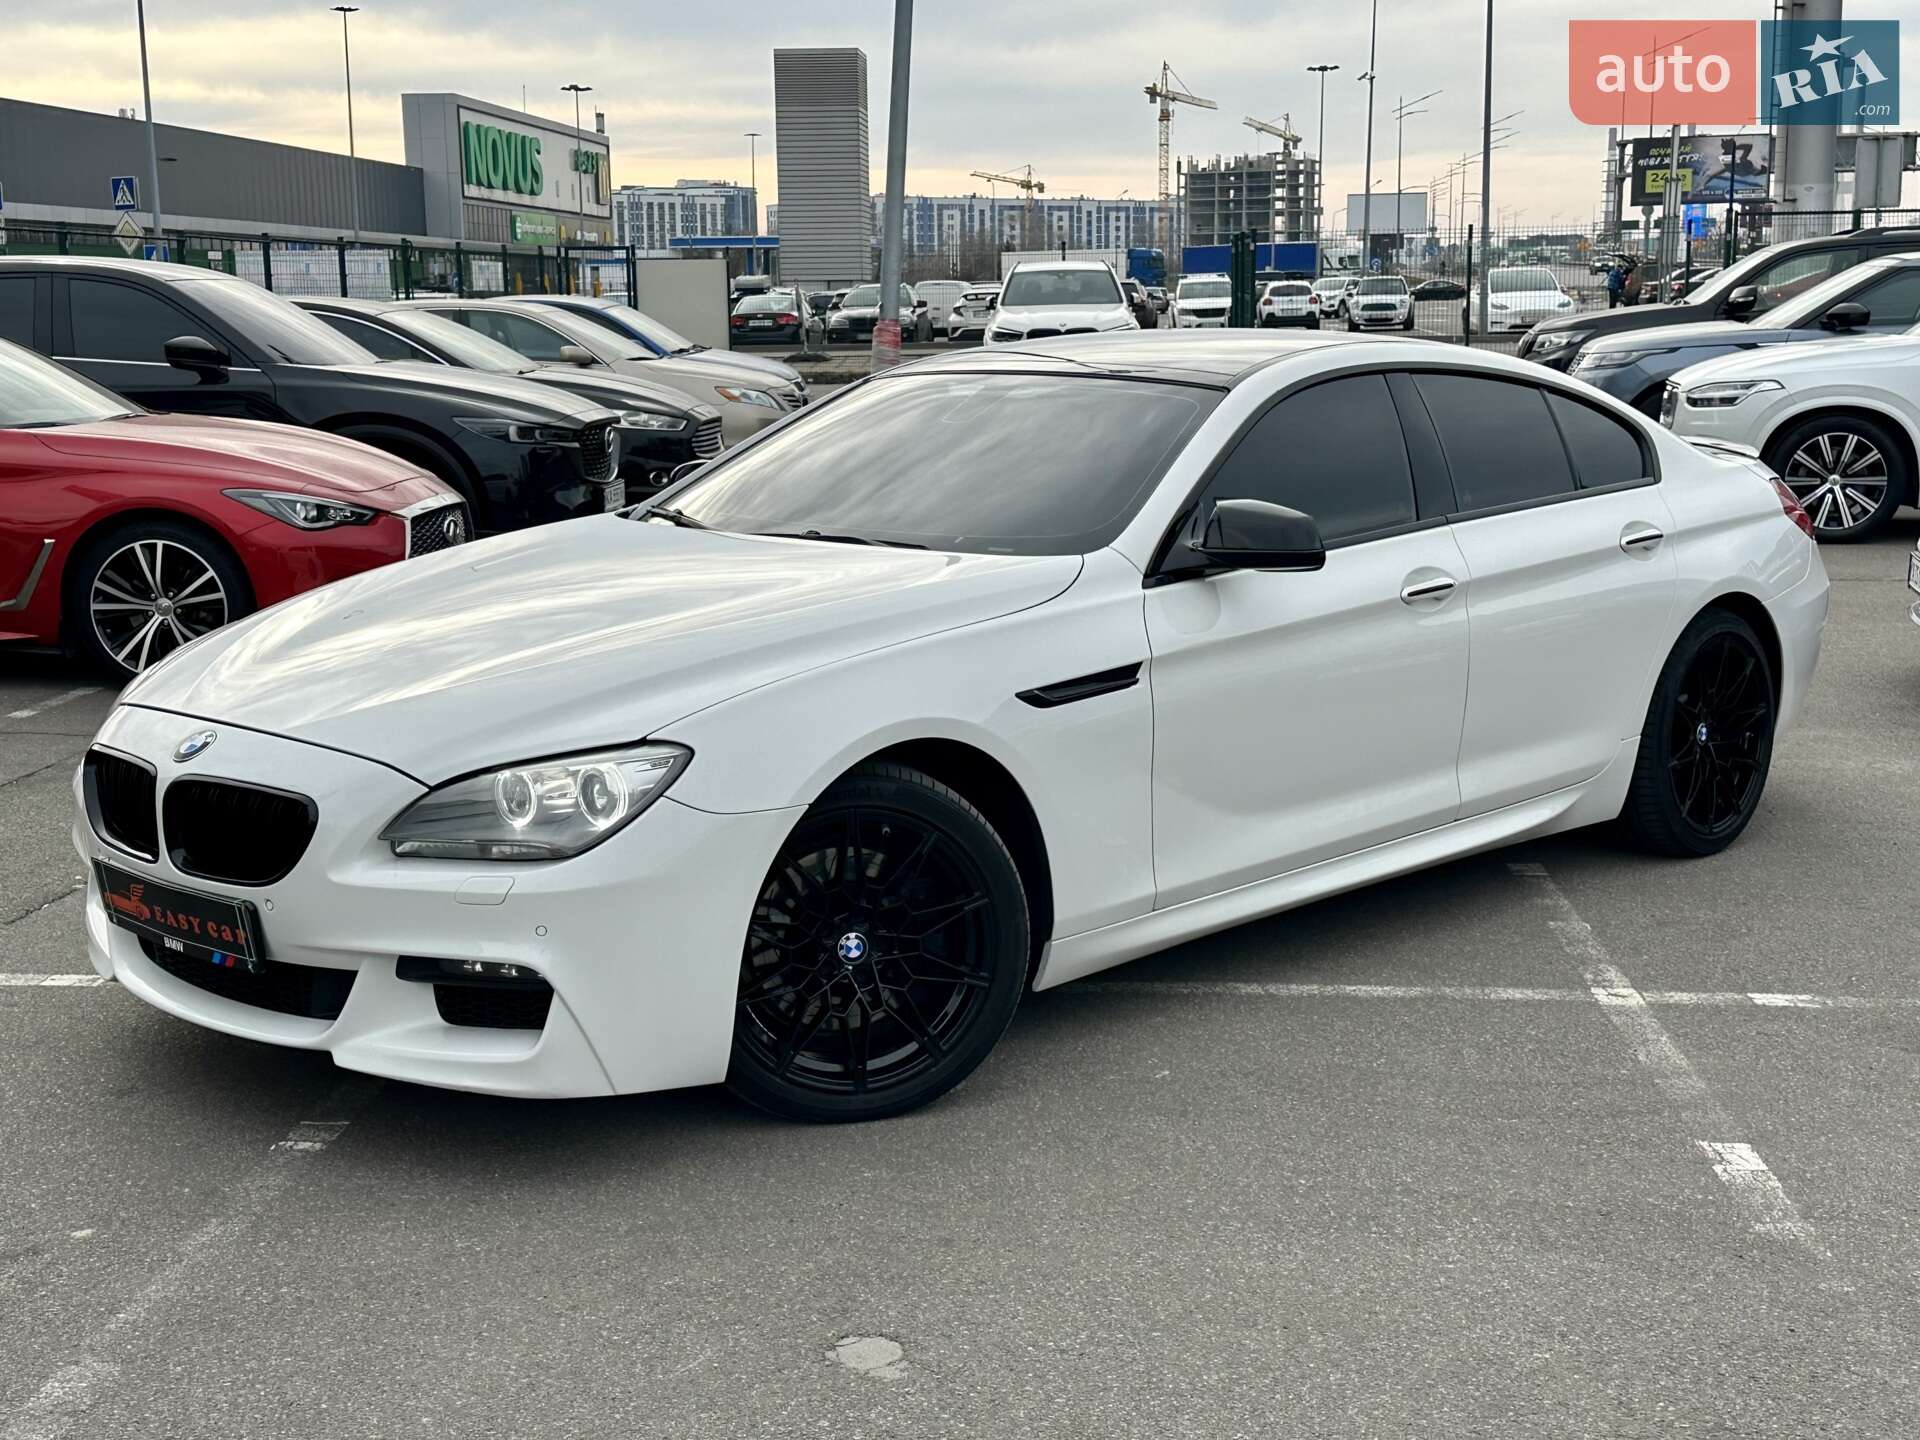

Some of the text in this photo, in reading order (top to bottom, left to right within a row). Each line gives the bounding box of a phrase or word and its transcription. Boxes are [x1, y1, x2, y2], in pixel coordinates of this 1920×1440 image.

[463, 121, 543, 196] NOVUS
[153, 904, 246, 945] EASY car
[163, 936, 184, 953] BMW
